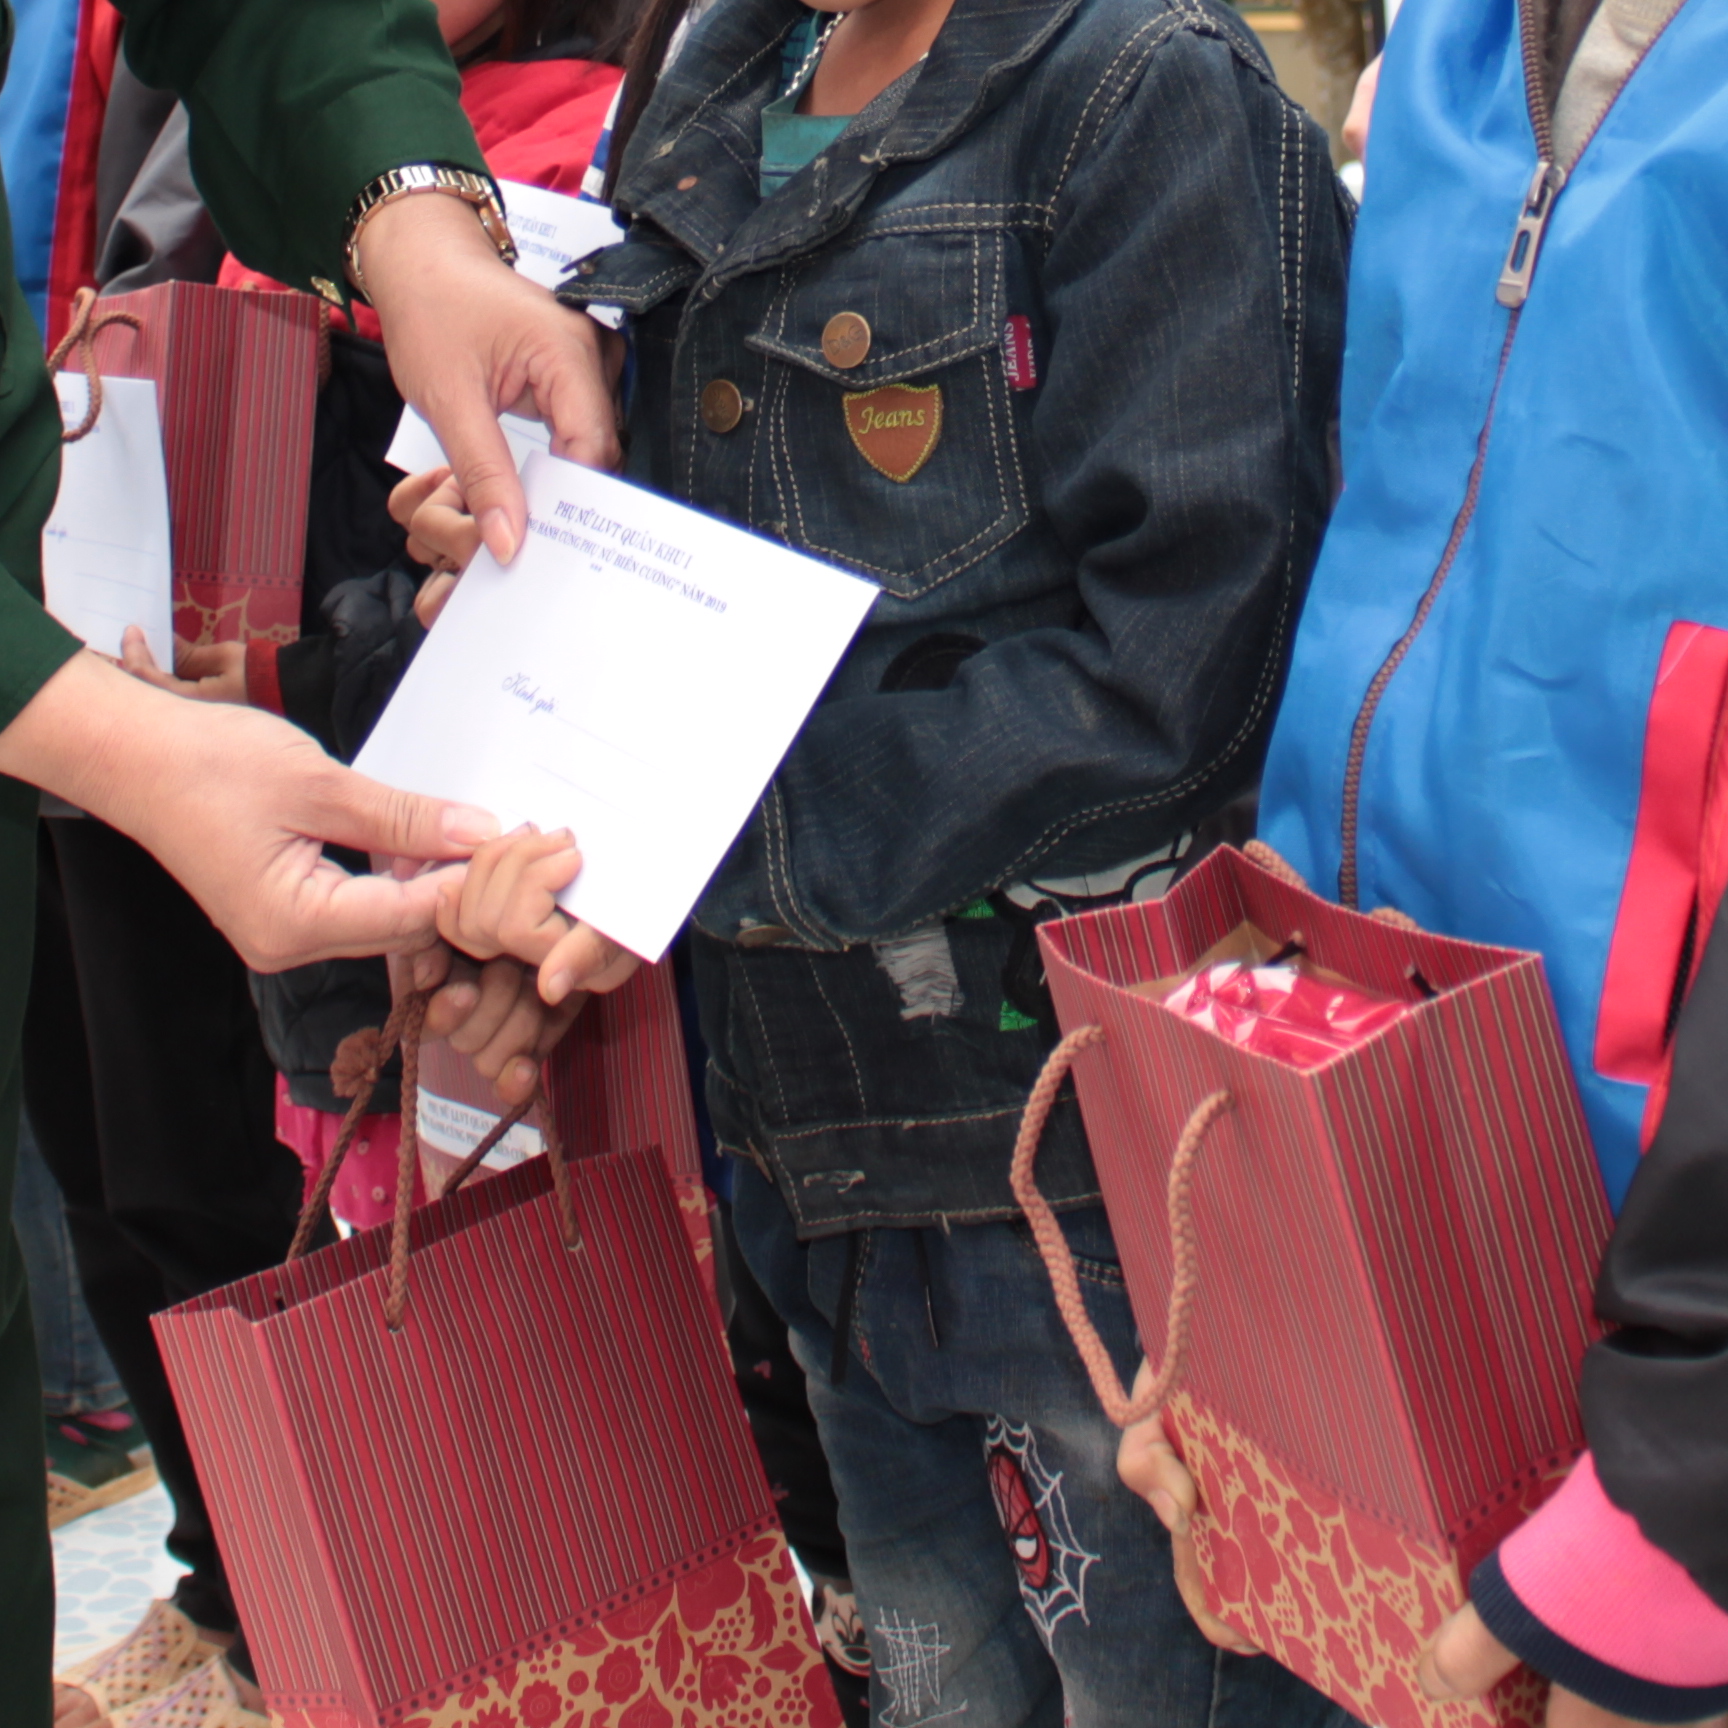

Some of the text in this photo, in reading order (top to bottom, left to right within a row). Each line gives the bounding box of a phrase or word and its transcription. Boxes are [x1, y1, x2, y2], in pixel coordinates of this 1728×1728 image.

[1004, 322, 1020, 382] JEANS
[858, 407, 926, 434] Jeans
[554, 500, 578, 523] PHỤ
[575, 508, 596, 526] NỮ
[590, 514, 622, 538] LLVT
[620, 528, 657, 553] QUÂN
[655, 542, 686, 565] KHU
[579, 538, 600, 558] PHỤ
[599, 547, 617, 563] NỮ
[613, 554, 640, 573] BIÊN
[679, 582, 705, 604] NĂM
[704, 595, 727, 614] 2019
